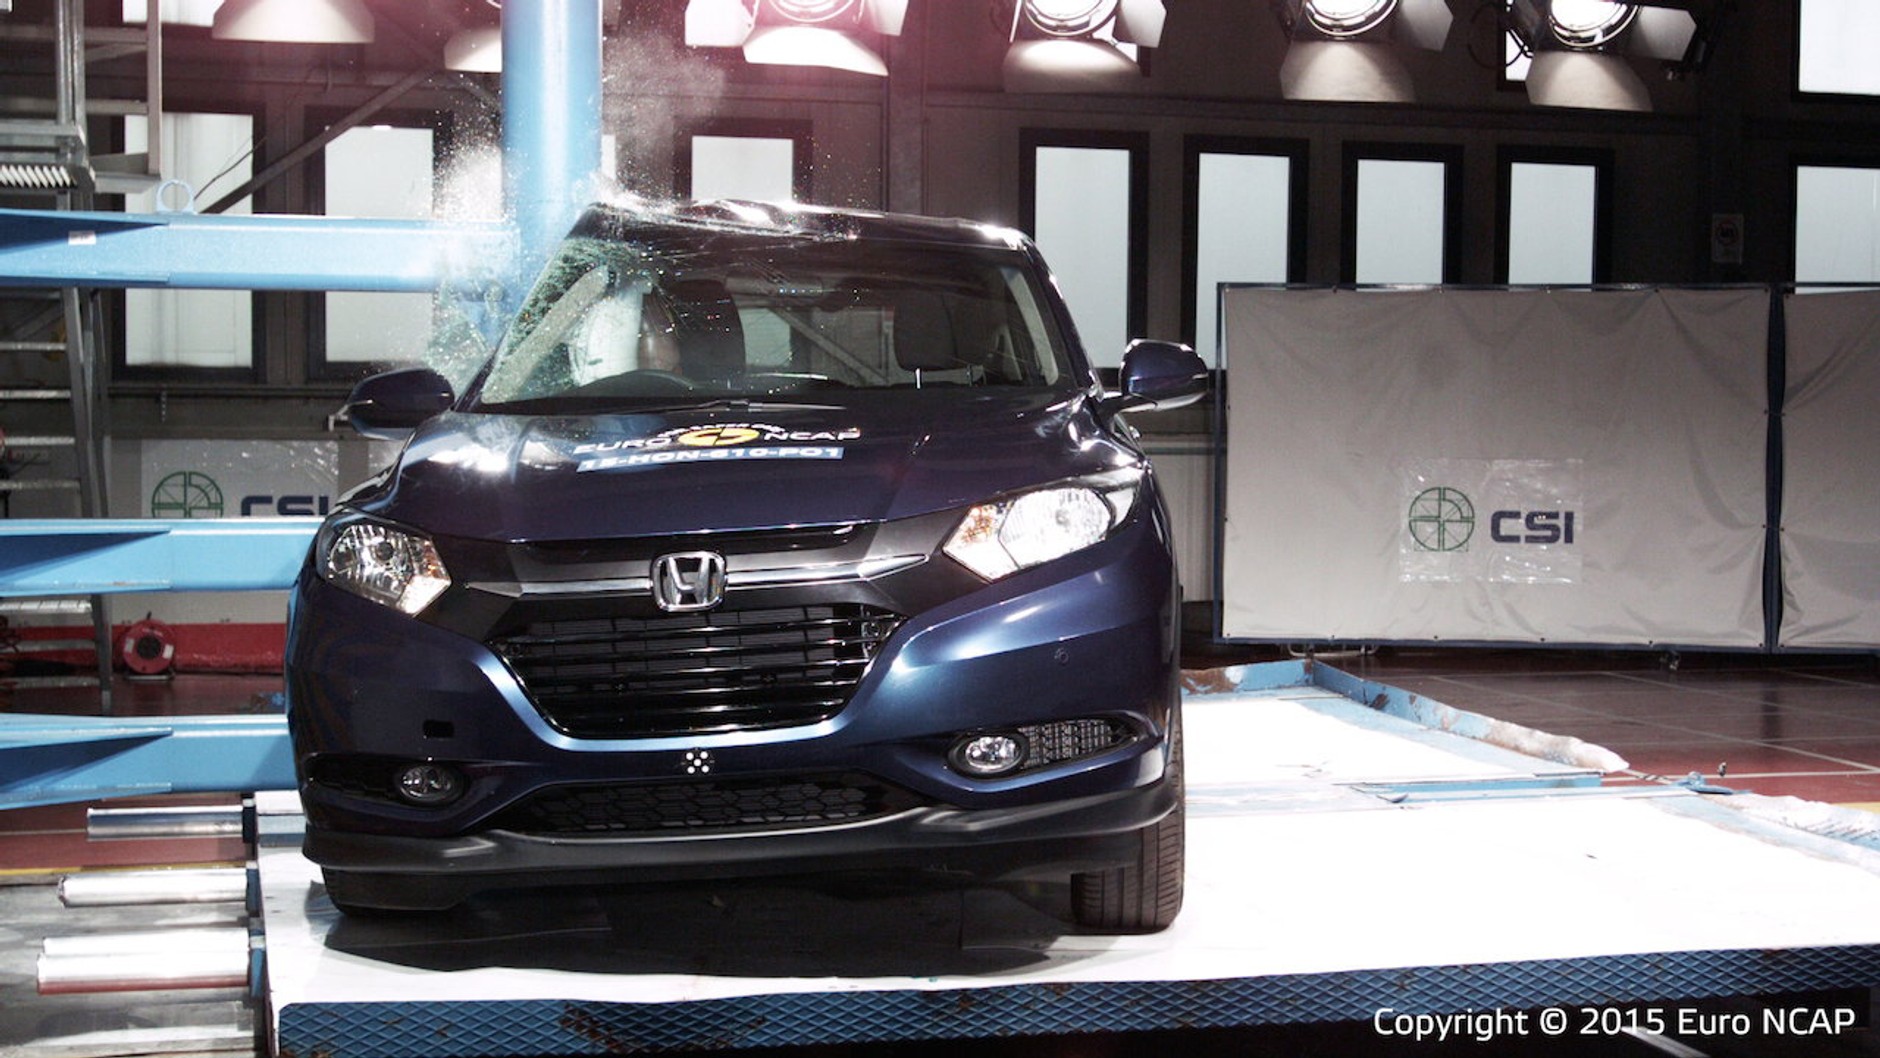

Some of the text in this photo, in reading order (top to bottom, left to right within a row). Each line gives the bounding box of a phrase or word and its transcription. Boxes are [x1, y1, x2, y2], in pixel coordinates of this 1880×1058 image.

[573, 428, 861, 455] EURO NCAP
[1491, 511, 1574, 544] CSI
